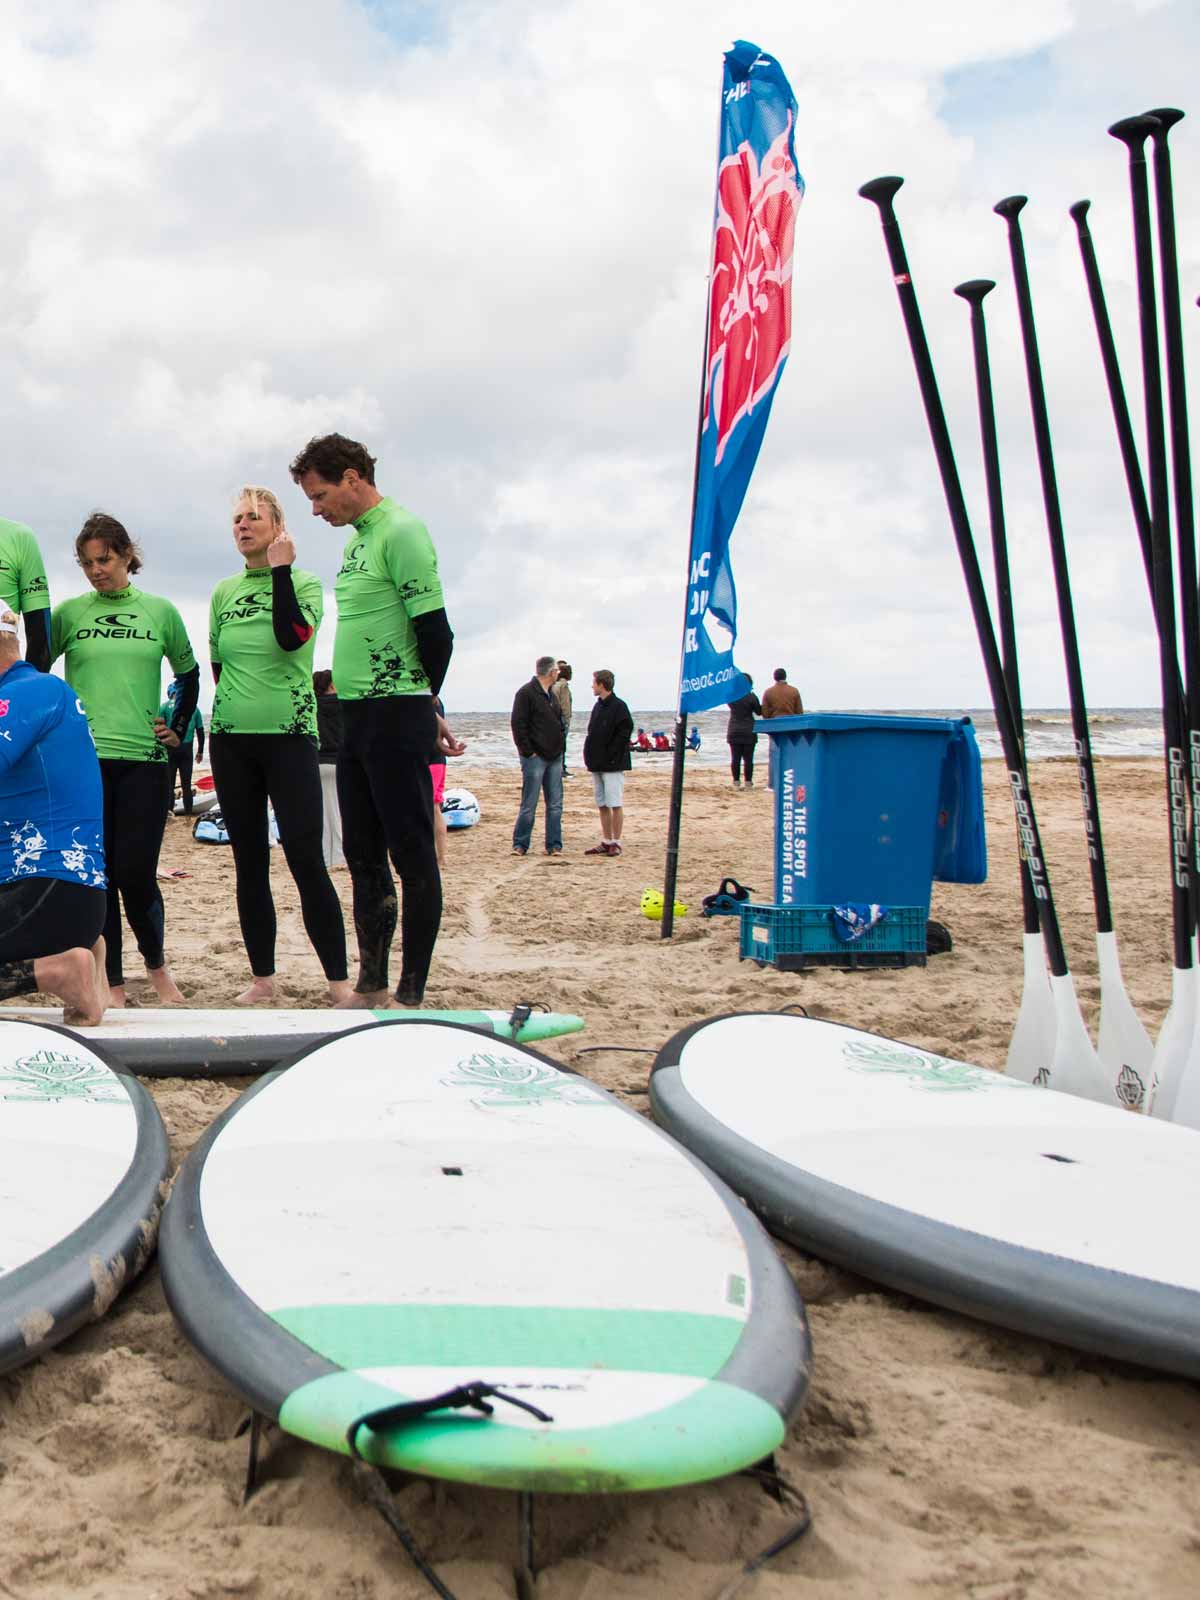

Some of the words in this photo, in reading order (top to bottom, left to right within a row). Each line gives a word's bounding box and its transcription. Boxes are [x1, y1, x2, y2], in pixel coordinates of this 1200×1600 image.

[76, 628, 158, 642] O'NEILL
[783, 768, 794, 872] WATERSPORT
[794, 806, 807, 835] THE
[1008, 770, 1049, 901] STARBOARD
[794, 838, 807, 878] SPOT
[782, 874, 793, 904] GEA
